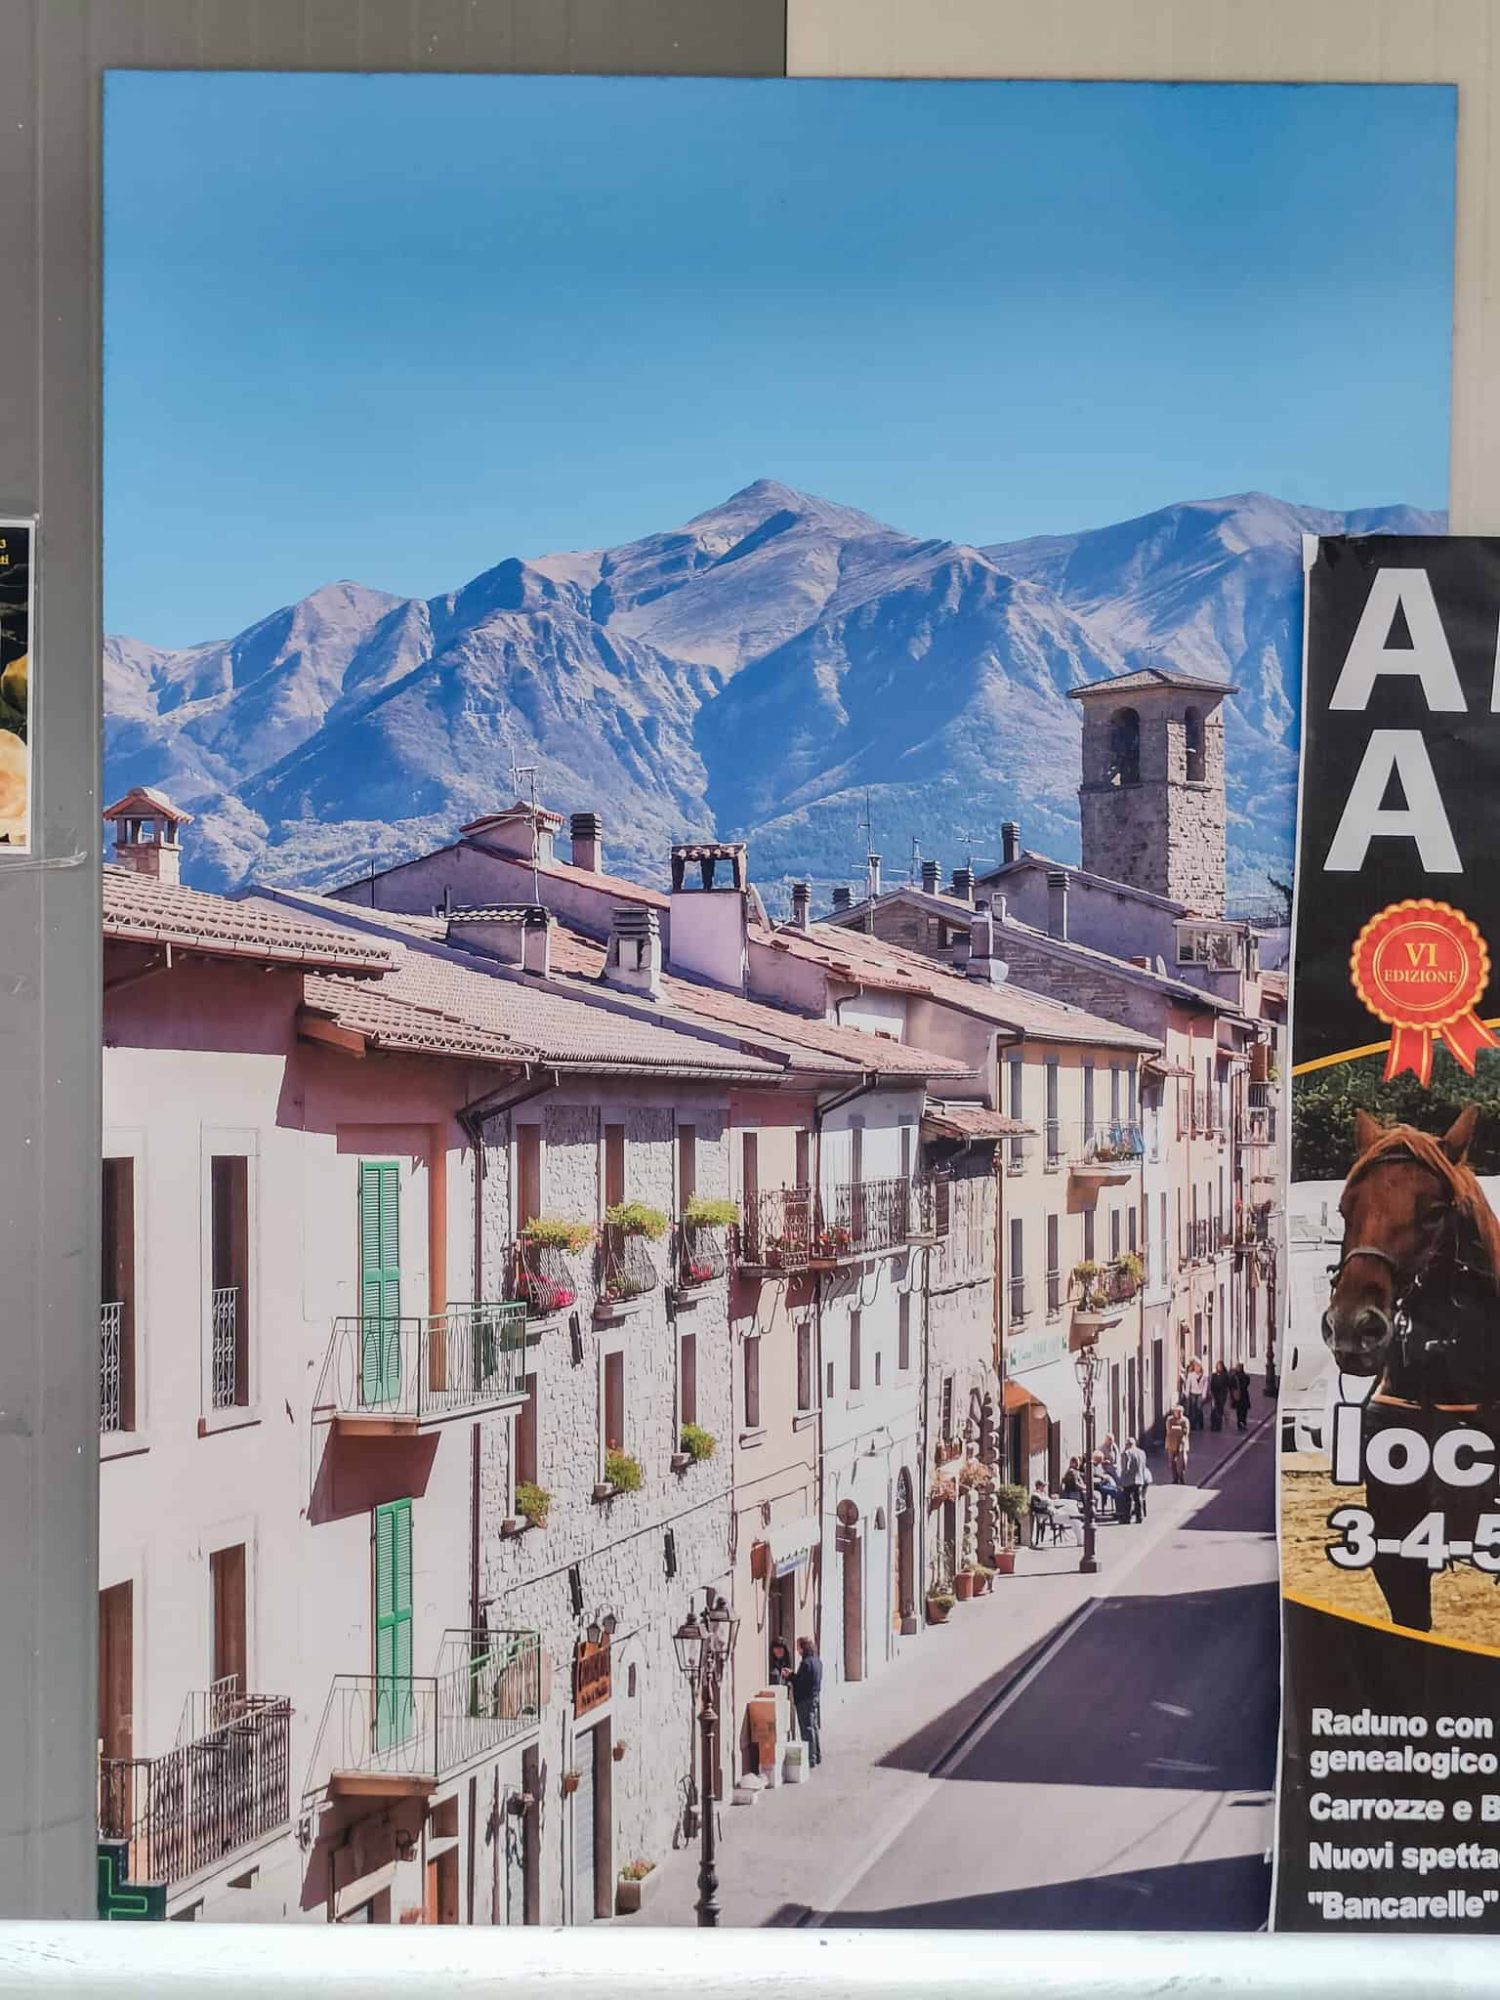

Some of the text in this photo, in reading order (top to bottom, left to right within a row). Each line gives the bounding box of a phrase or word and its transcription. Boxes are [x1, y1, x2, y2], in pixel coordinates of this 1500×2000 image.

[1328, 567, 1500, 713] A
[1322, 729, 1464, 874] A
[1404, 942, 1438, 967] VI
[1383, 969, 1457, 983] EDIZIONE
[1336, 1406, 1500, 1487] loc
[1311, 1708, 1494, 1738] Raduno con
[1310, 1745, 1498, 1779] genealogico
[1309, 1792, 1445, 1820] Carrozze
[1452, 1800, 1473, 1821] e
[1309, 1841, 1500, 1875] Nuovi spetta
[1307, 1890, 1499, 1919] "Bancarelle"
